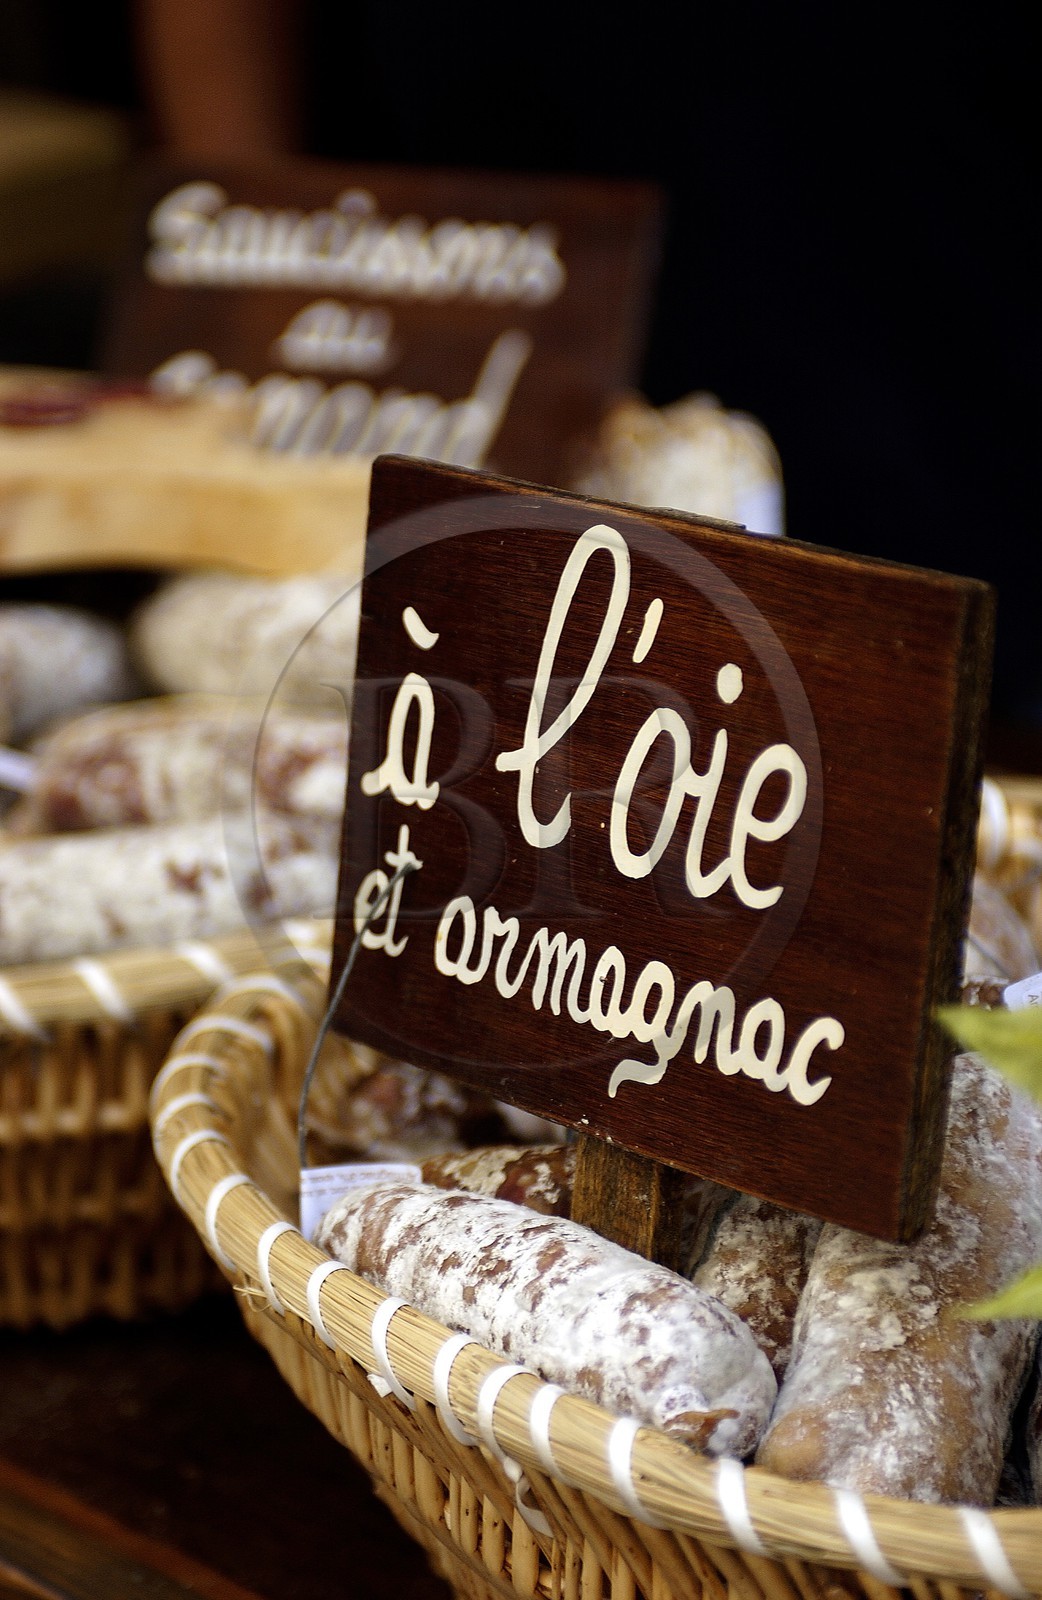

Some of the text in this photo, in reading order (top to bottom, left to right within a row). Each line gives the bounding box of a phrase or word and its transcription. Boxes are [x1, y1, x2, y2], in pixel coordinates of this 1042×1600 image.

[361, 523, 808, 910] à l'oie
[353, 824, 845, 1106] et armagnac
